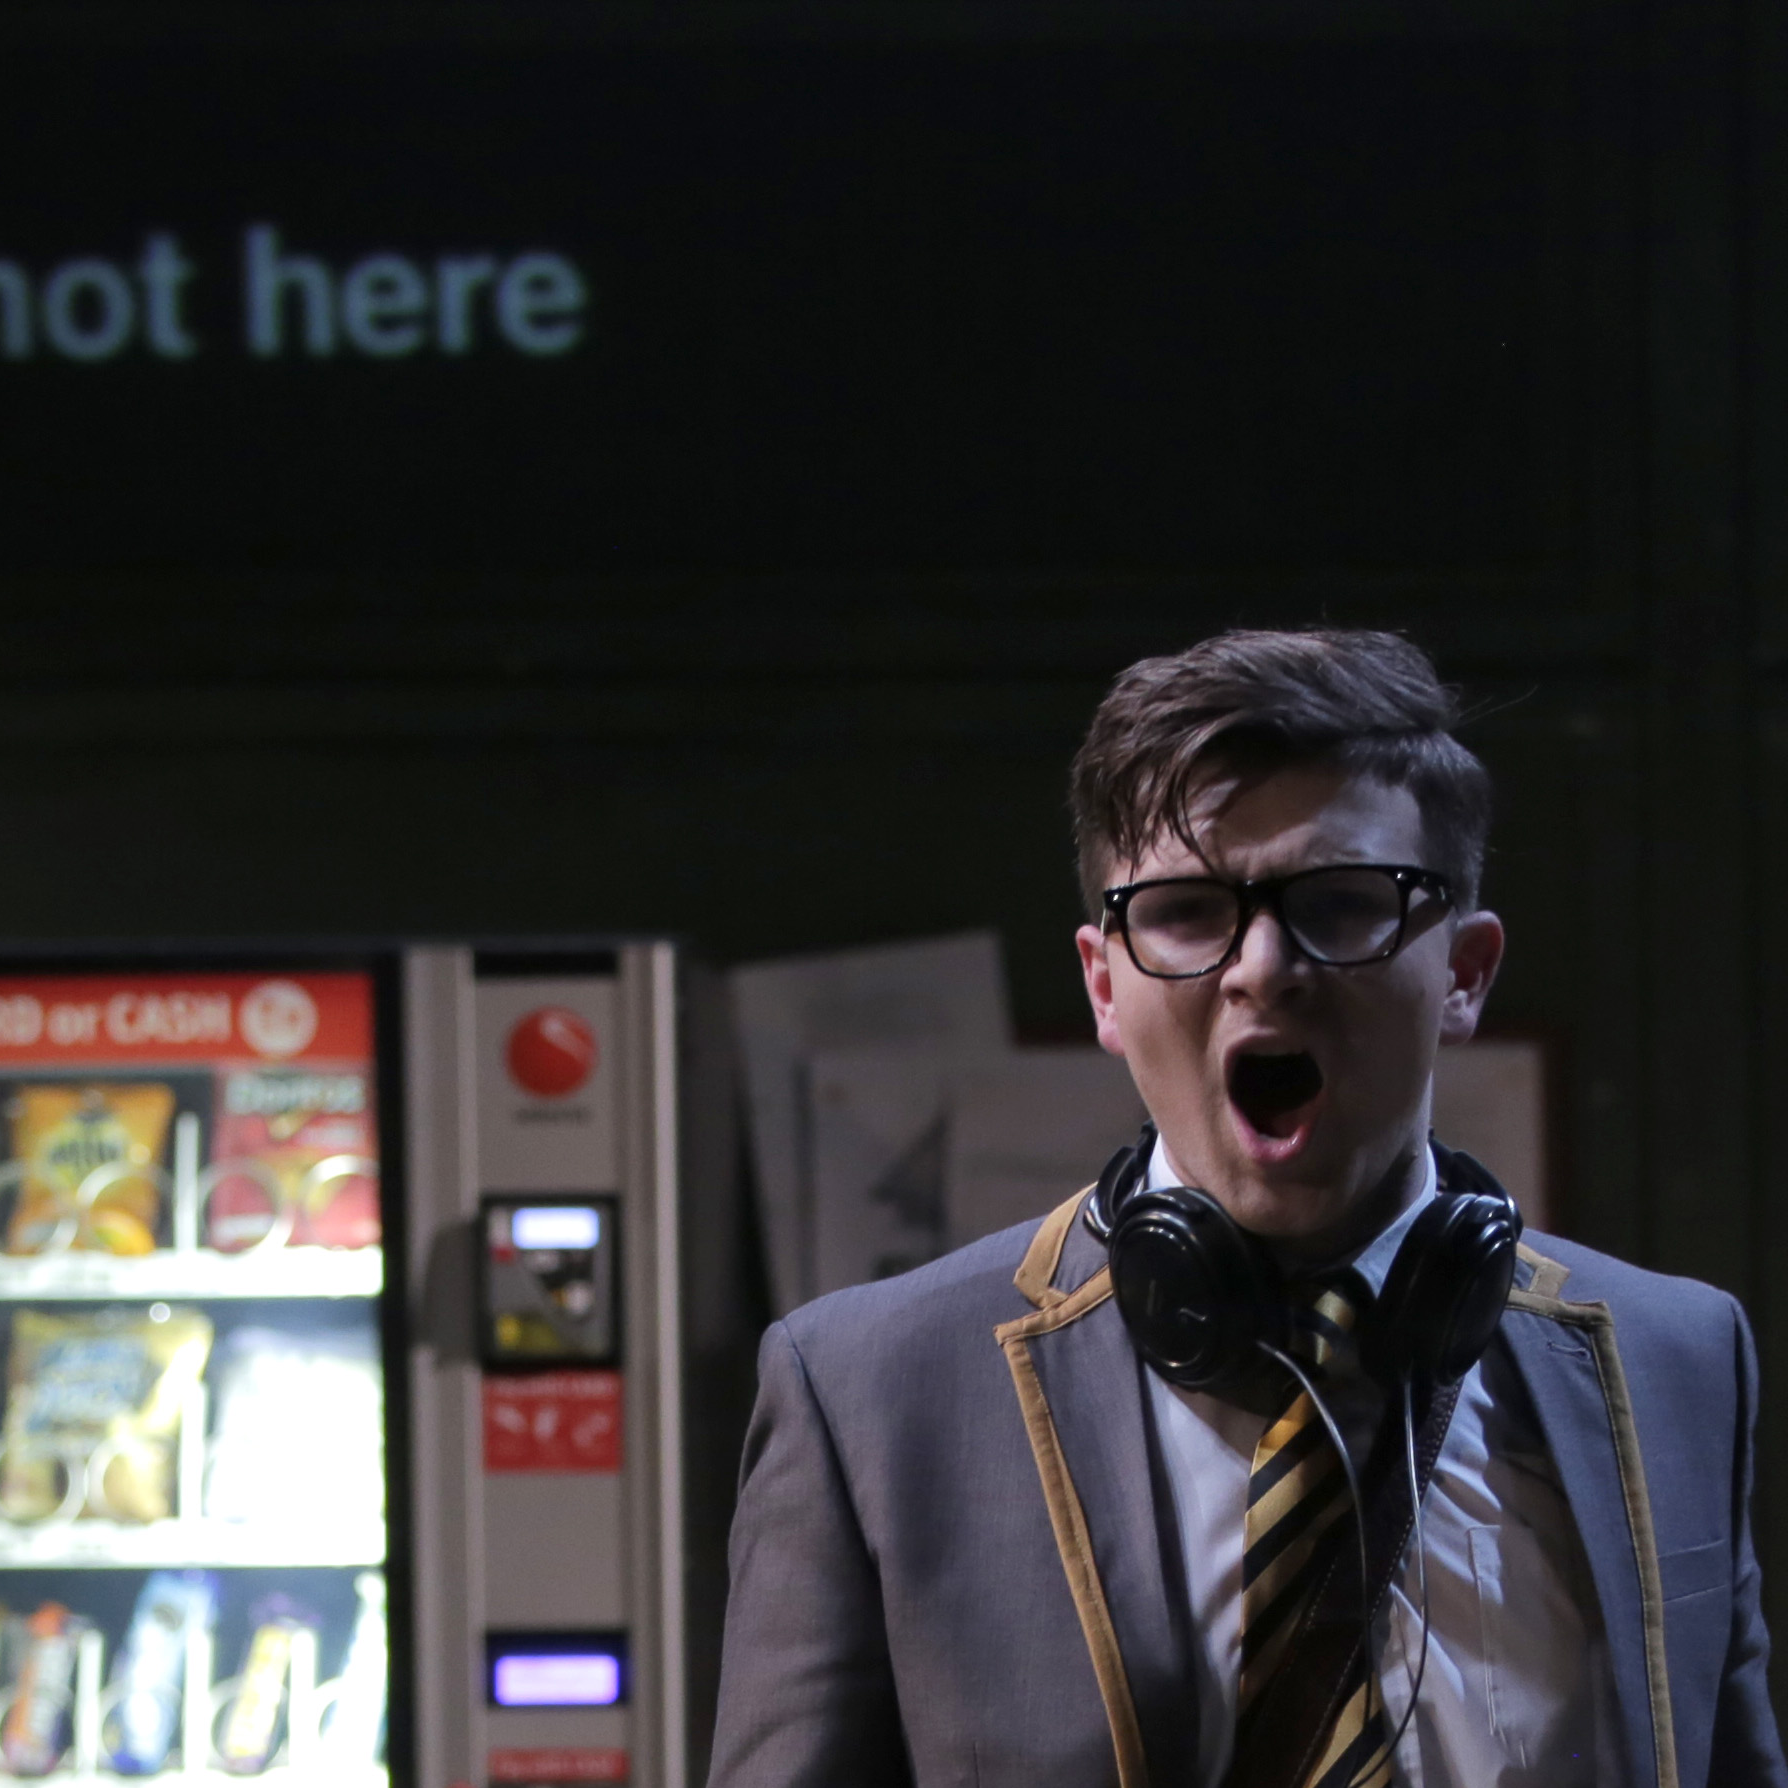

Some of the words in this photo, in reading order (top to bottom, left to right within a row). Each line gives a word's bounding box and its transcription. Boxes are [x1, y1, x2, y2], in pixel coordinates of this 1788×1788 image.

[245, 226, 587, 356] here
[48, 1004, 100, 1046] or
[106, 993, 231, 1044] CASH
